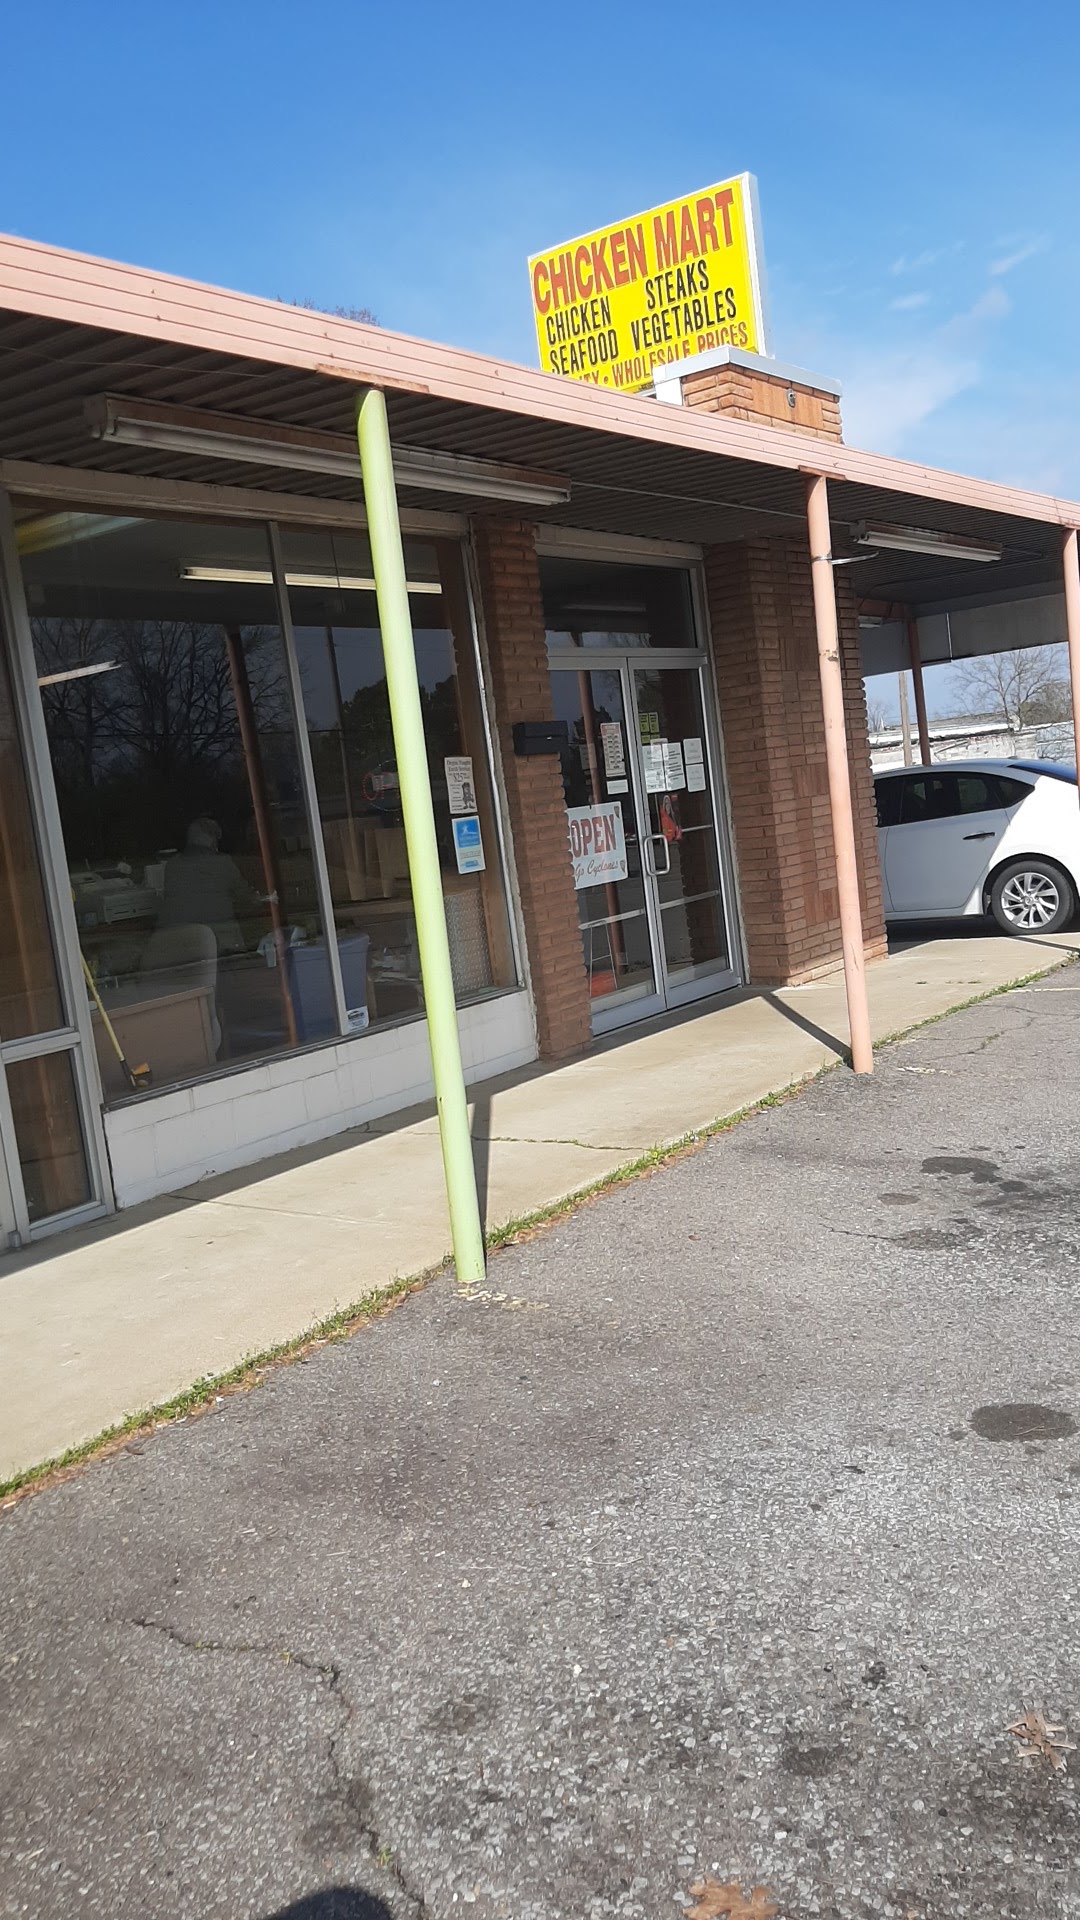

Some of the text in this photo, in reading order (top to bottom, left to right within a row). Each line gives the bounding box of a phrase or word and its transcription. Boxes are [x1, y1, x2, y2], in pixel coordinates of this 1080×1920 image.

[533, 188, 734, 314] CHICKEN MART
[546, 260, 709, 346] CHICKEN STEAKS
[550, 287, 737, 376] SEAFOOD VEGETABLES
[612, 321, 748, 388] WHOLESALE PRICES
[571, 814, 617, 858] OPEN
[575, 862, 584, 883] Go
